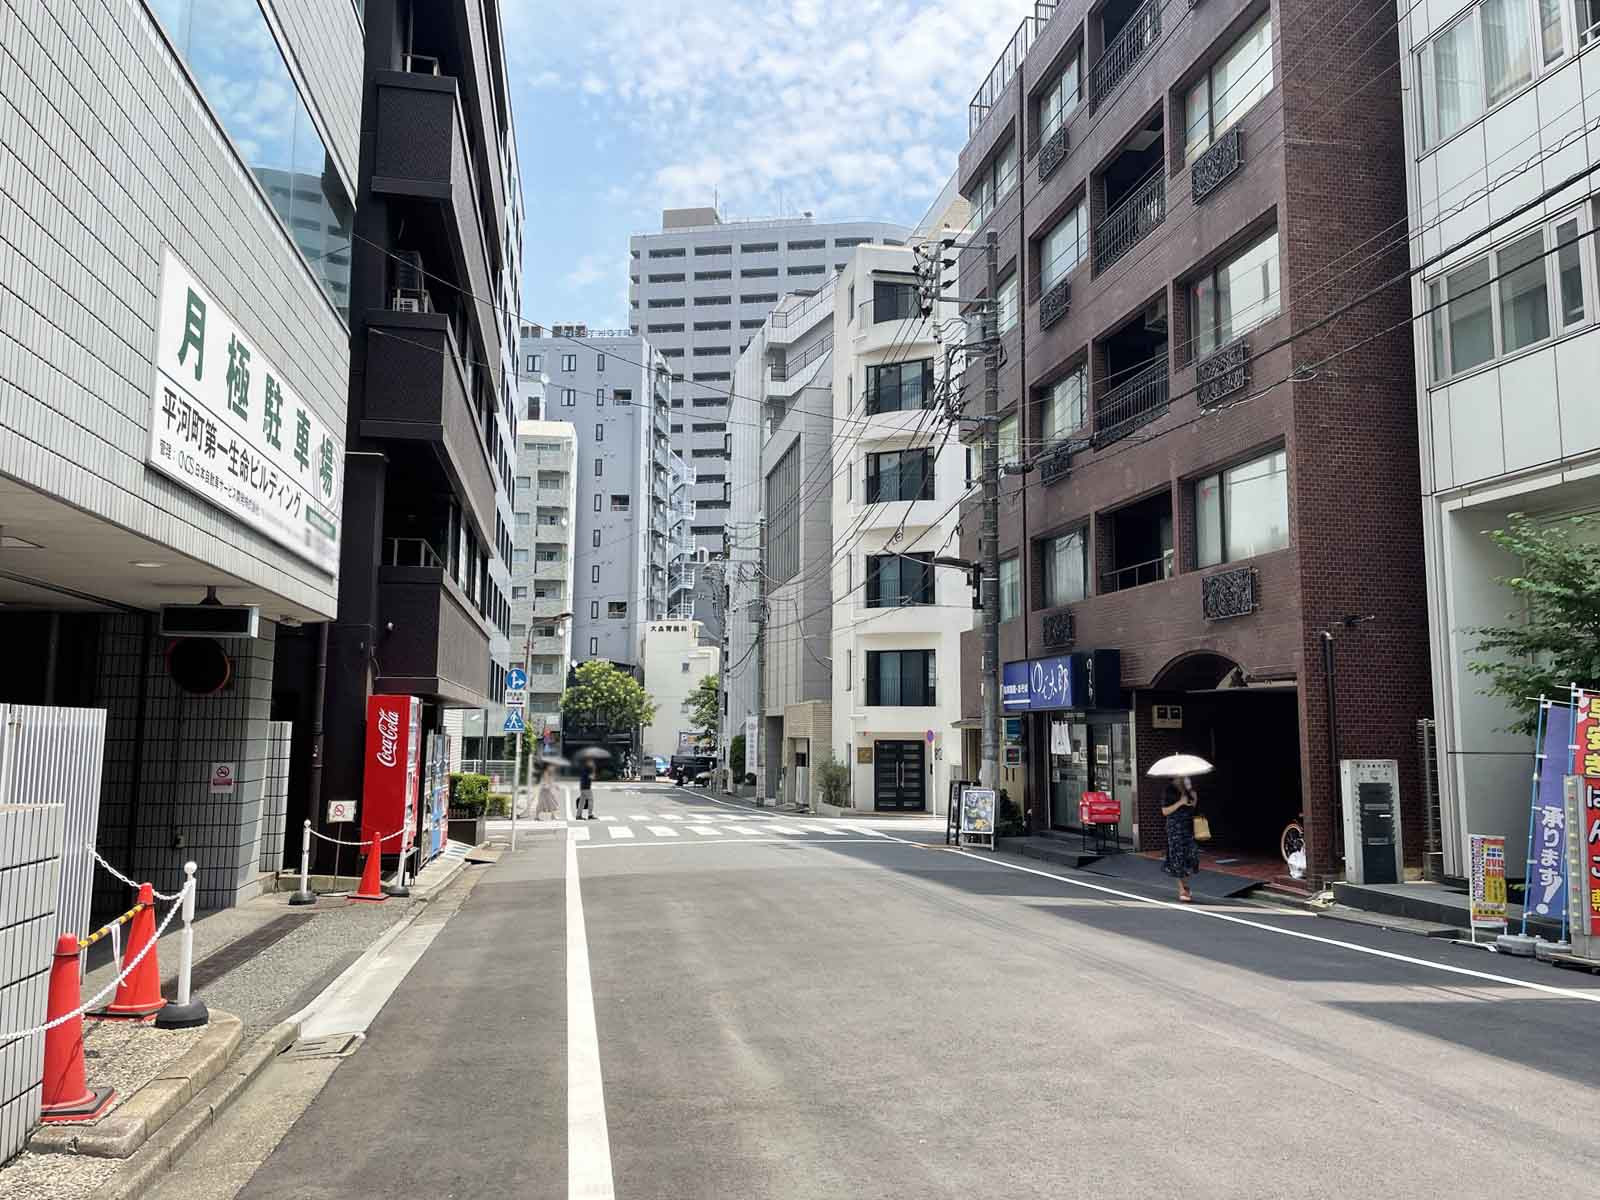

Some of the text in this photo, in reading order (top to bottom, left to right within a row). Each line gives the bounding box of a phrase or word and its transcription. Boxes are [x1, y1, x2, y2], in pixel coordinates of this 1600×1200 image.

[162, 386, 302, 518] 平河町第一生命ビルディング
[177, 286, 334, 498] 月極駐車場
